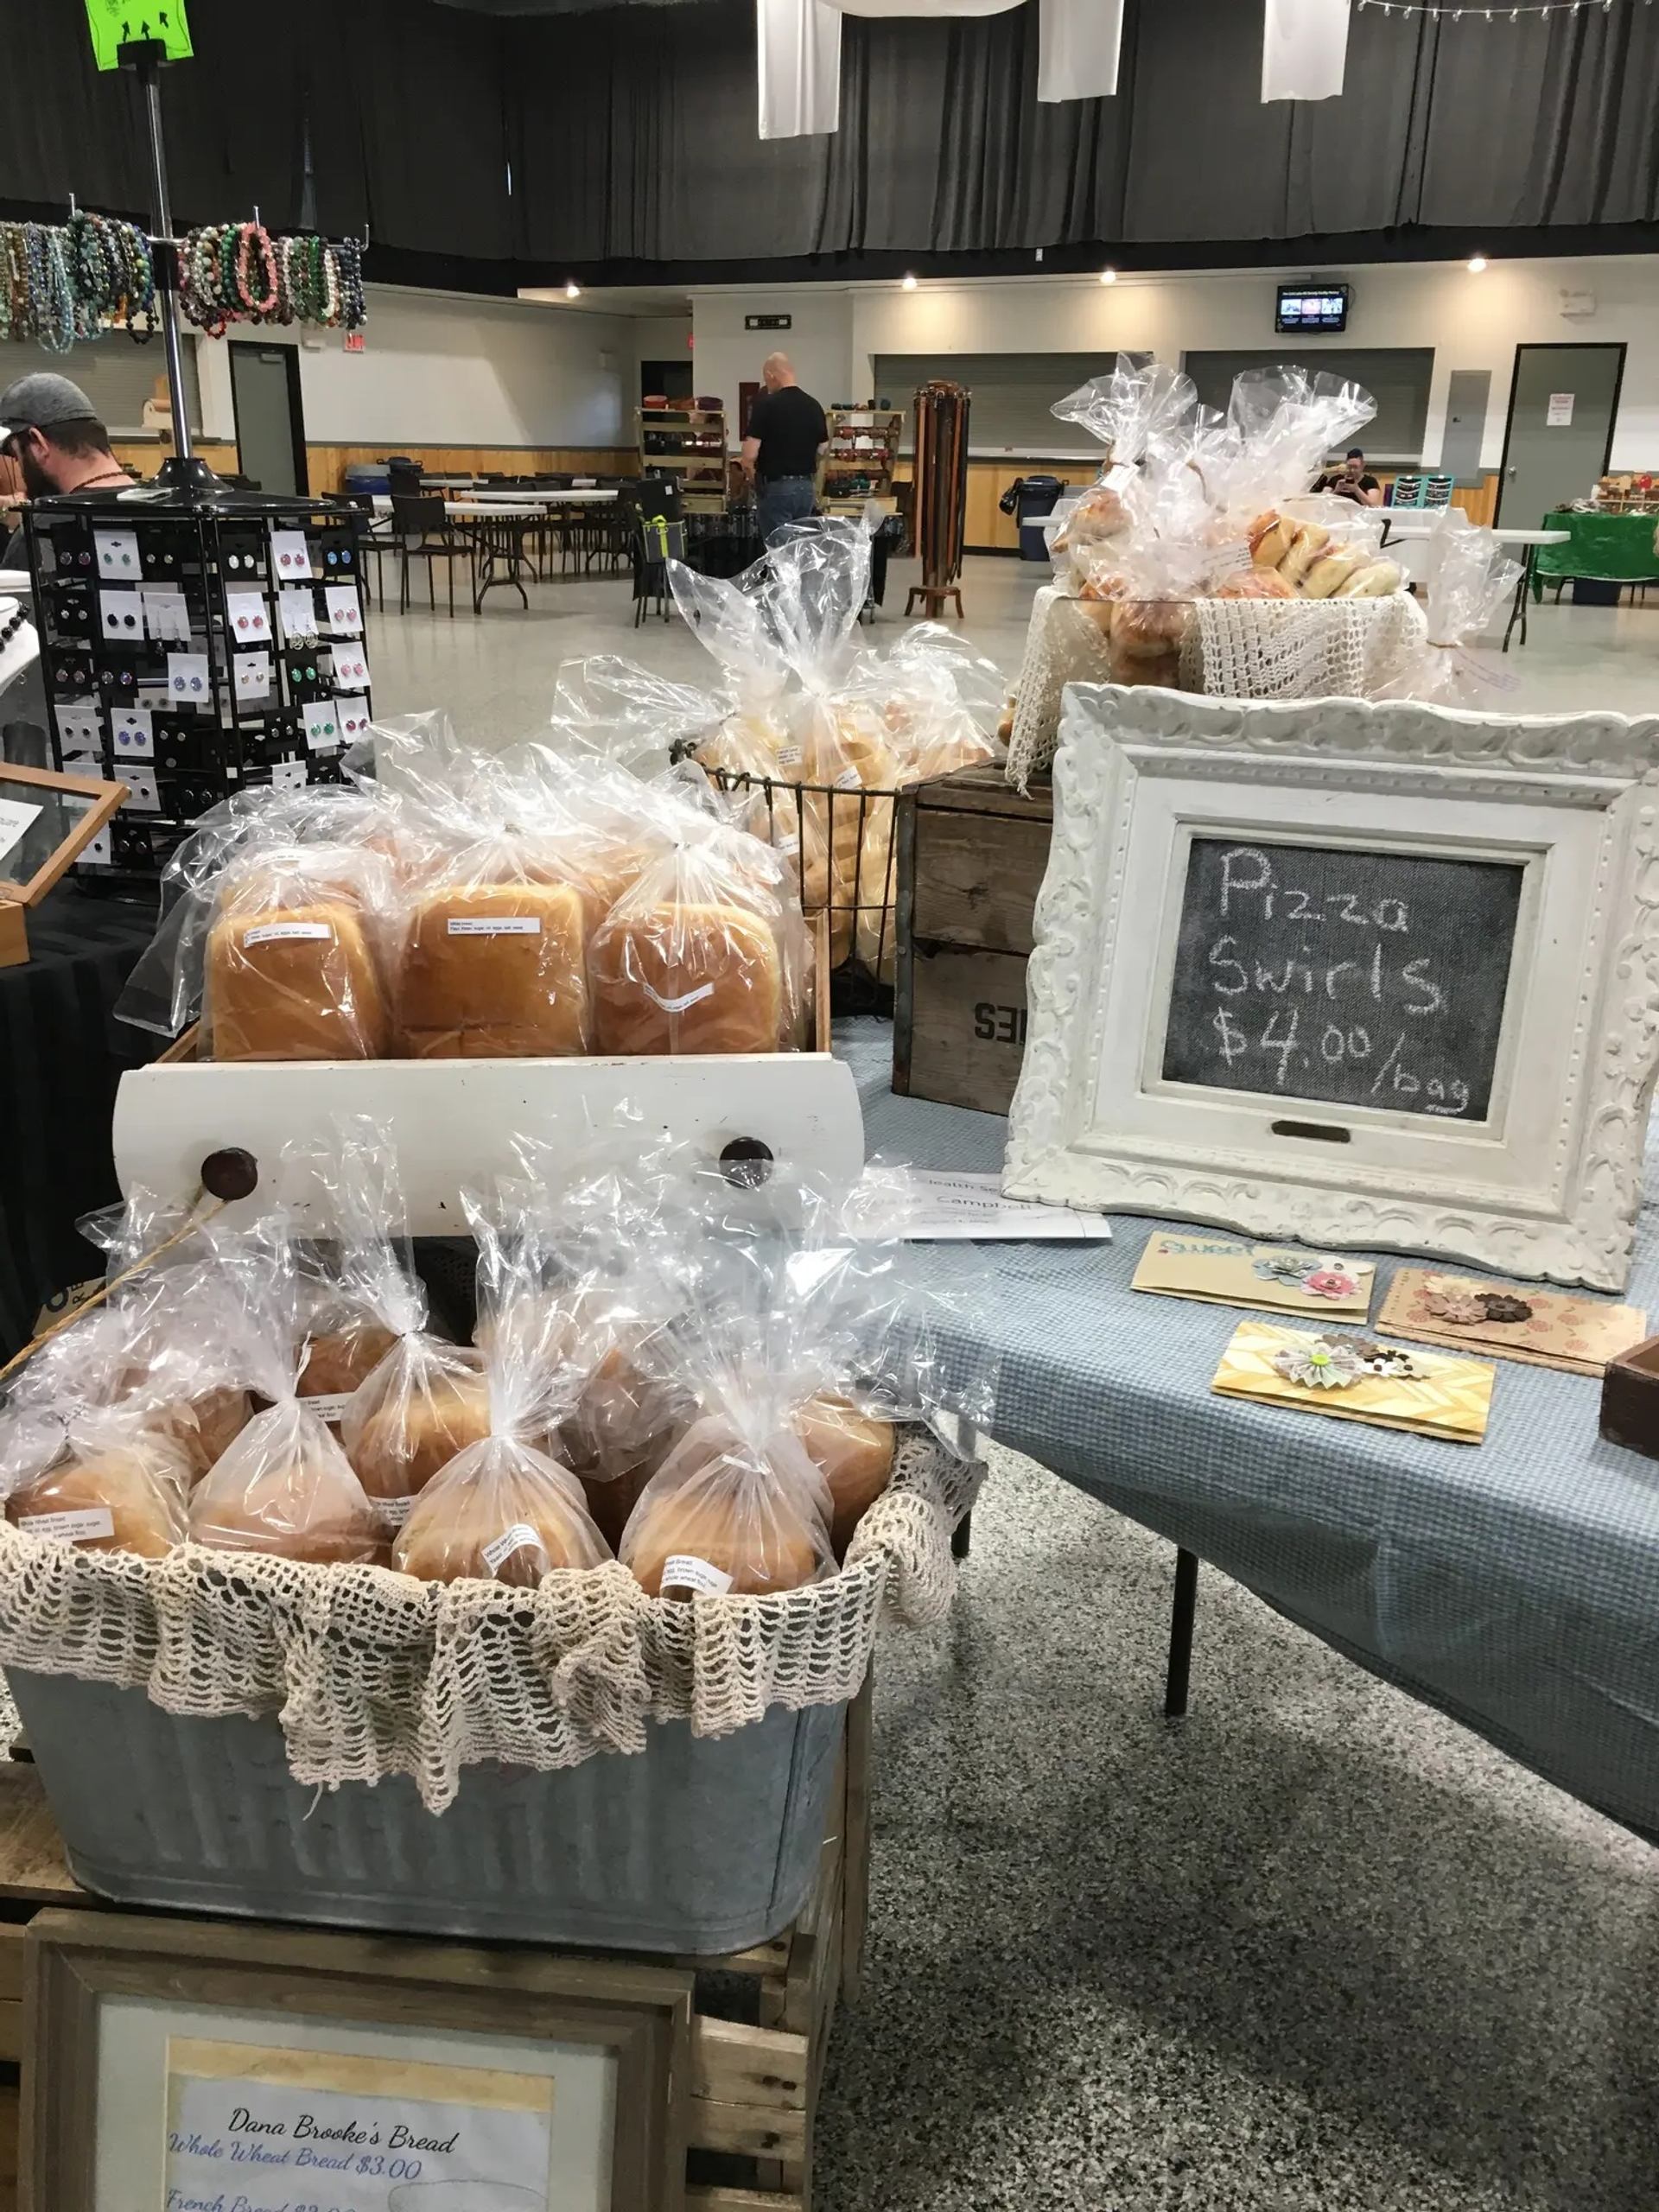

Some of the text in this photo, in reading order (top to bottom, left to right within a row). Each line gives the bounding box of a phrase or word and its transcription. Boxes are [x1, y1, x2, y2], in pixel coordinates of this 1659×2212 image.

[1219, 847, 1409, 933] Pizza
[974, 1002, 1027, 1045] IES
[936, 1195, 1032, 1211] Campbell
[228, 2107, 461, 2154] Dana Brooke's Bread
[168, 2133, 423, 2181] Whole Wheat Bread $3.00
[166, 2188, 226, 2212] French
